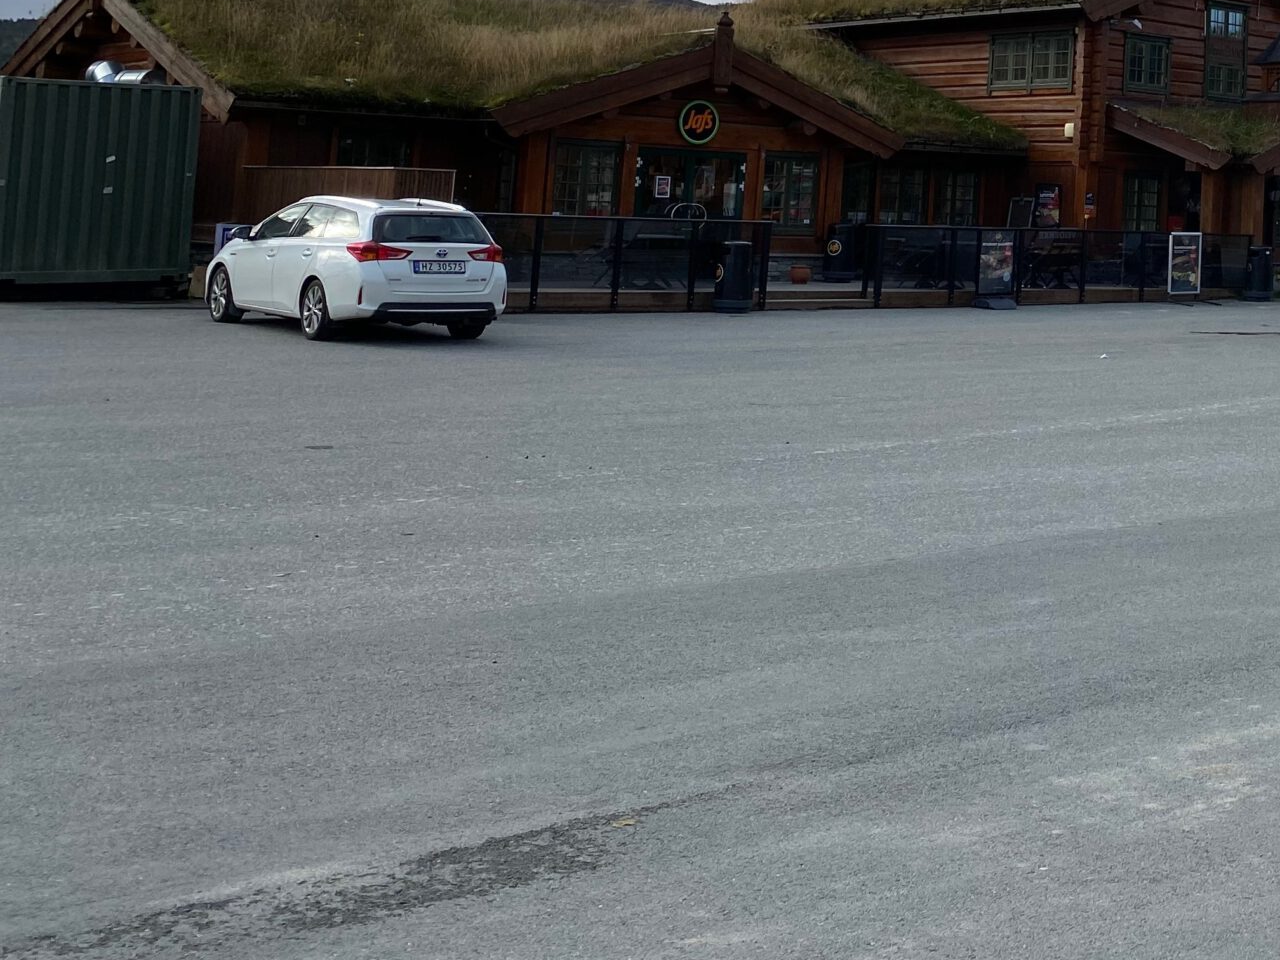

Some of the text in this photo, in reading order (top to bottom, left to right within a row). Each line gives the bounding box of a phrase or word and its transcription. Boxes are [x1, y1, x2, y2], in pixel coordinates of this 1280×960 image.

[684, 108, 713, 134] Jafs
[421, 262, 463, 271] HZ 30575
